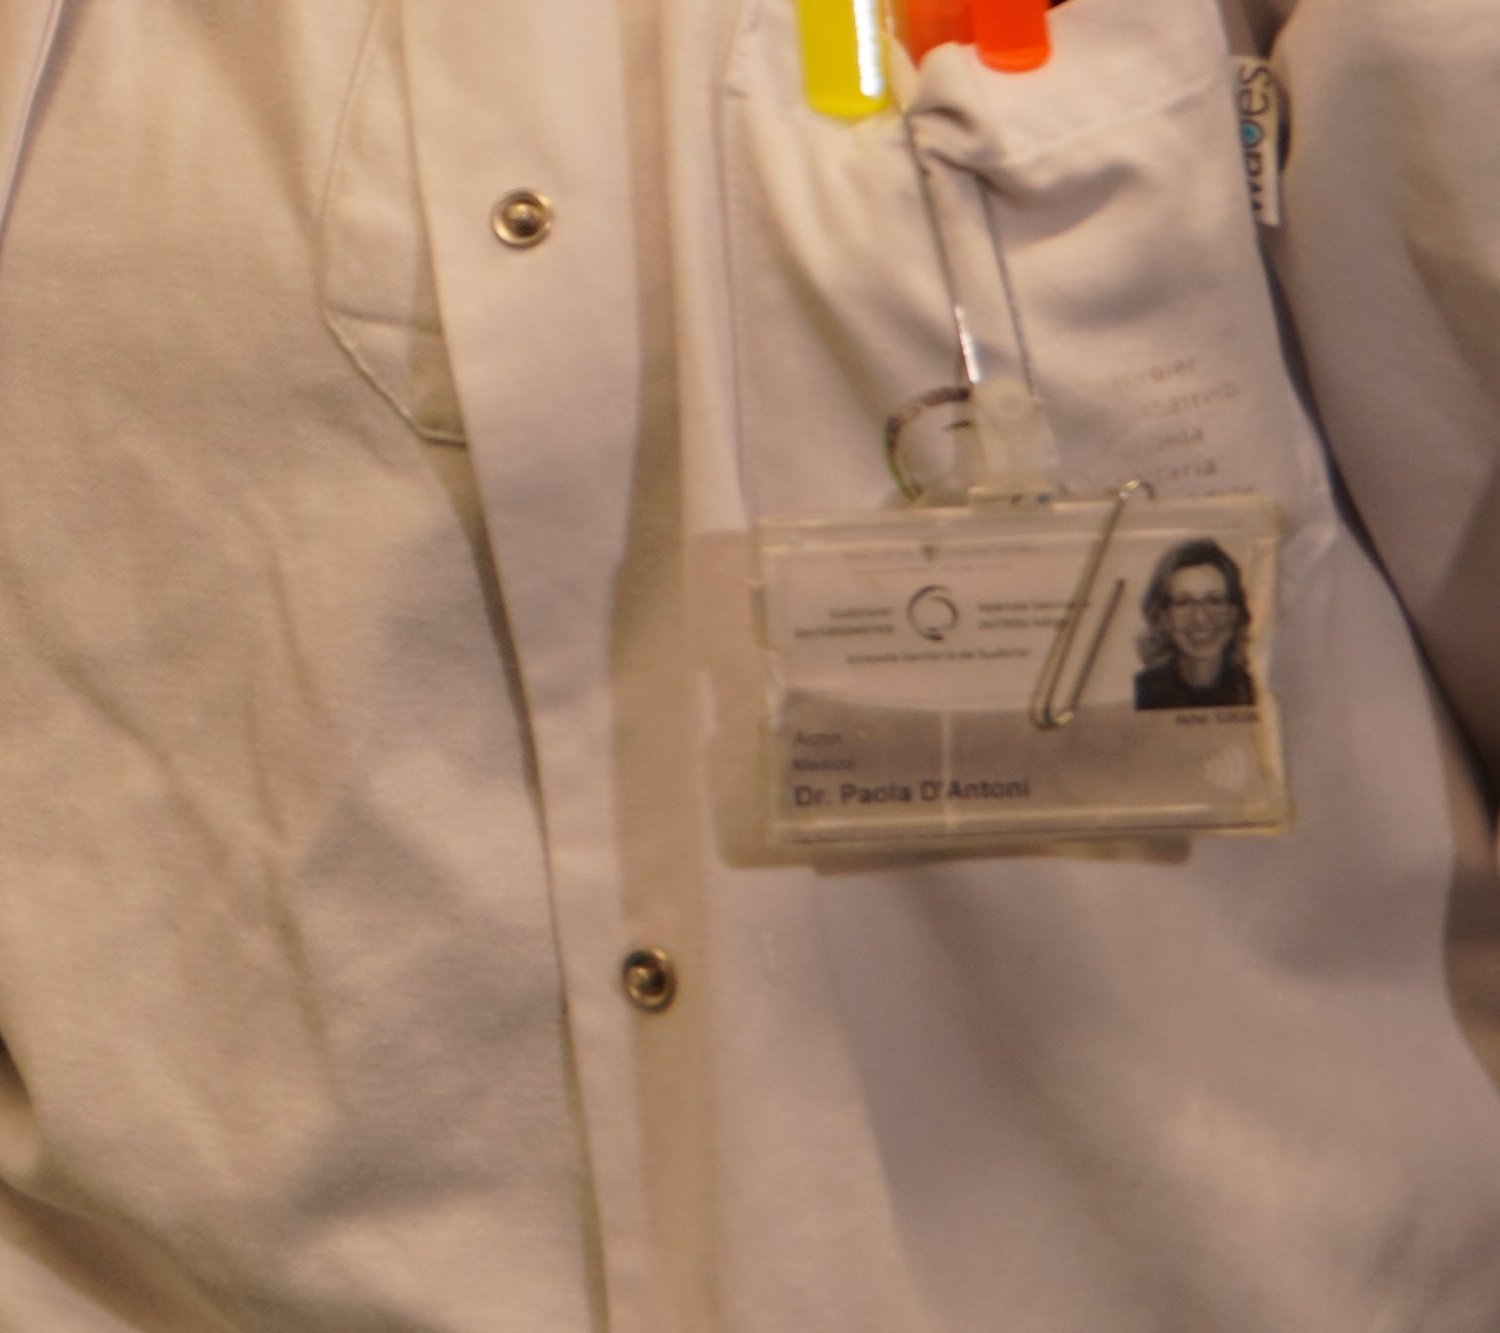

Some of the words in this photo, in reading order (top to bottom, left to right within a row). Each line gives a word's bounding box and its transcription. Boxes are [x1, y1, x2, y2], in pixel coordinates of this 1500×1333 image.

[793, 783, 829, 807] Dr.
[840, 781, 911, 805] Paola
[919, 777, 1030, 801] D'Antoni
